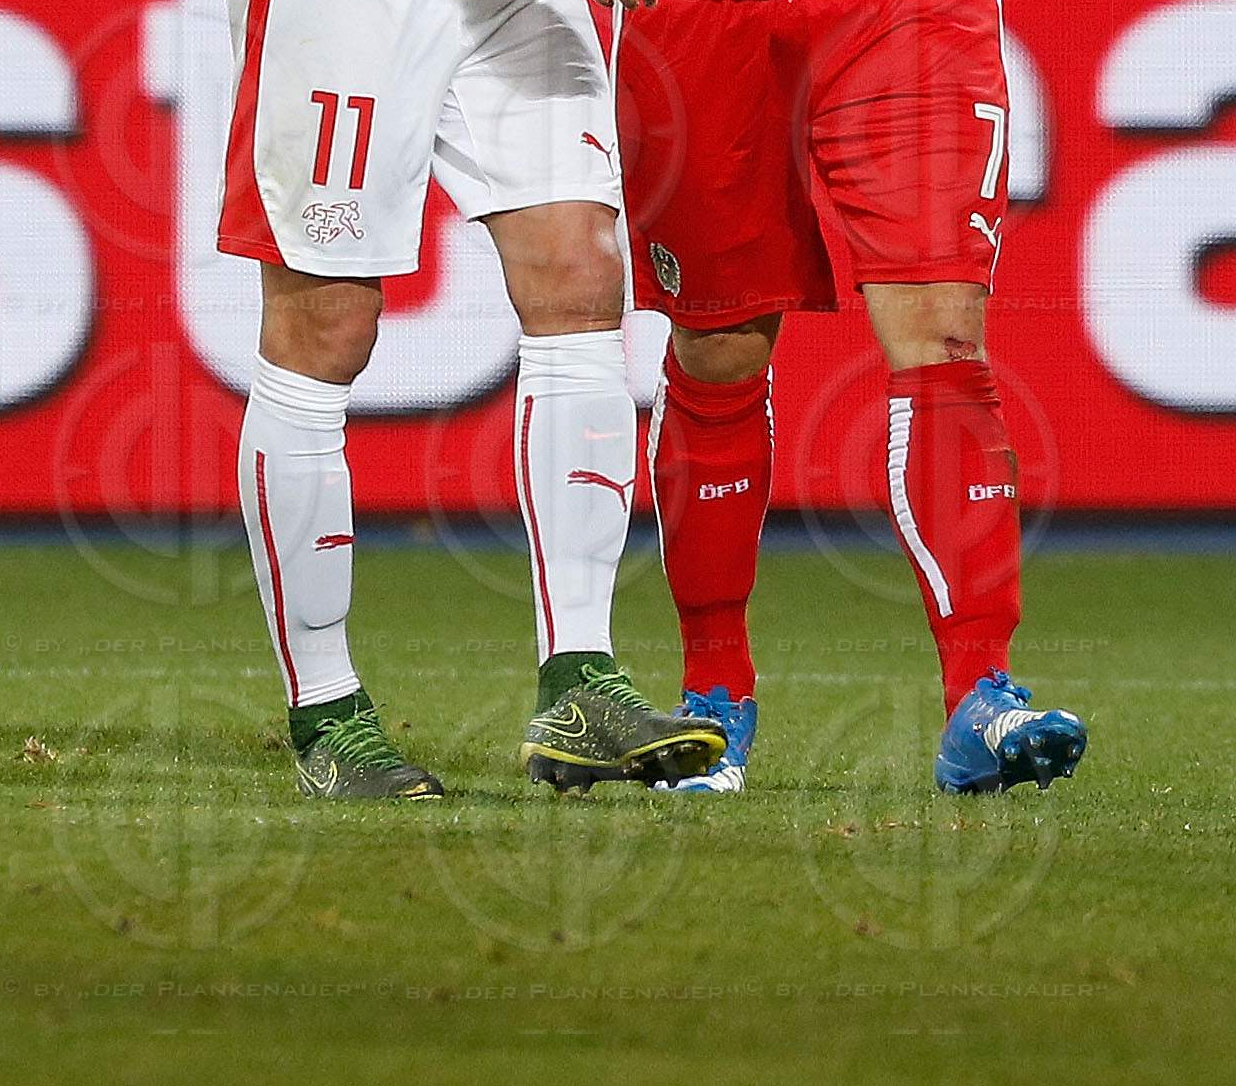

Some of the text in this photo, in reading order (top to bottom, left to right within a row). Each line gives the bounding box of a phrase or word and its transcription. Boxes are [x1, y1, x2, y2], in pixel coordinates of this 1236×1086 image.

[311, 90, 375, 190] 11
[974, 101, 1004, 199] 7
[699, 478, 749, 500] ÖFB
